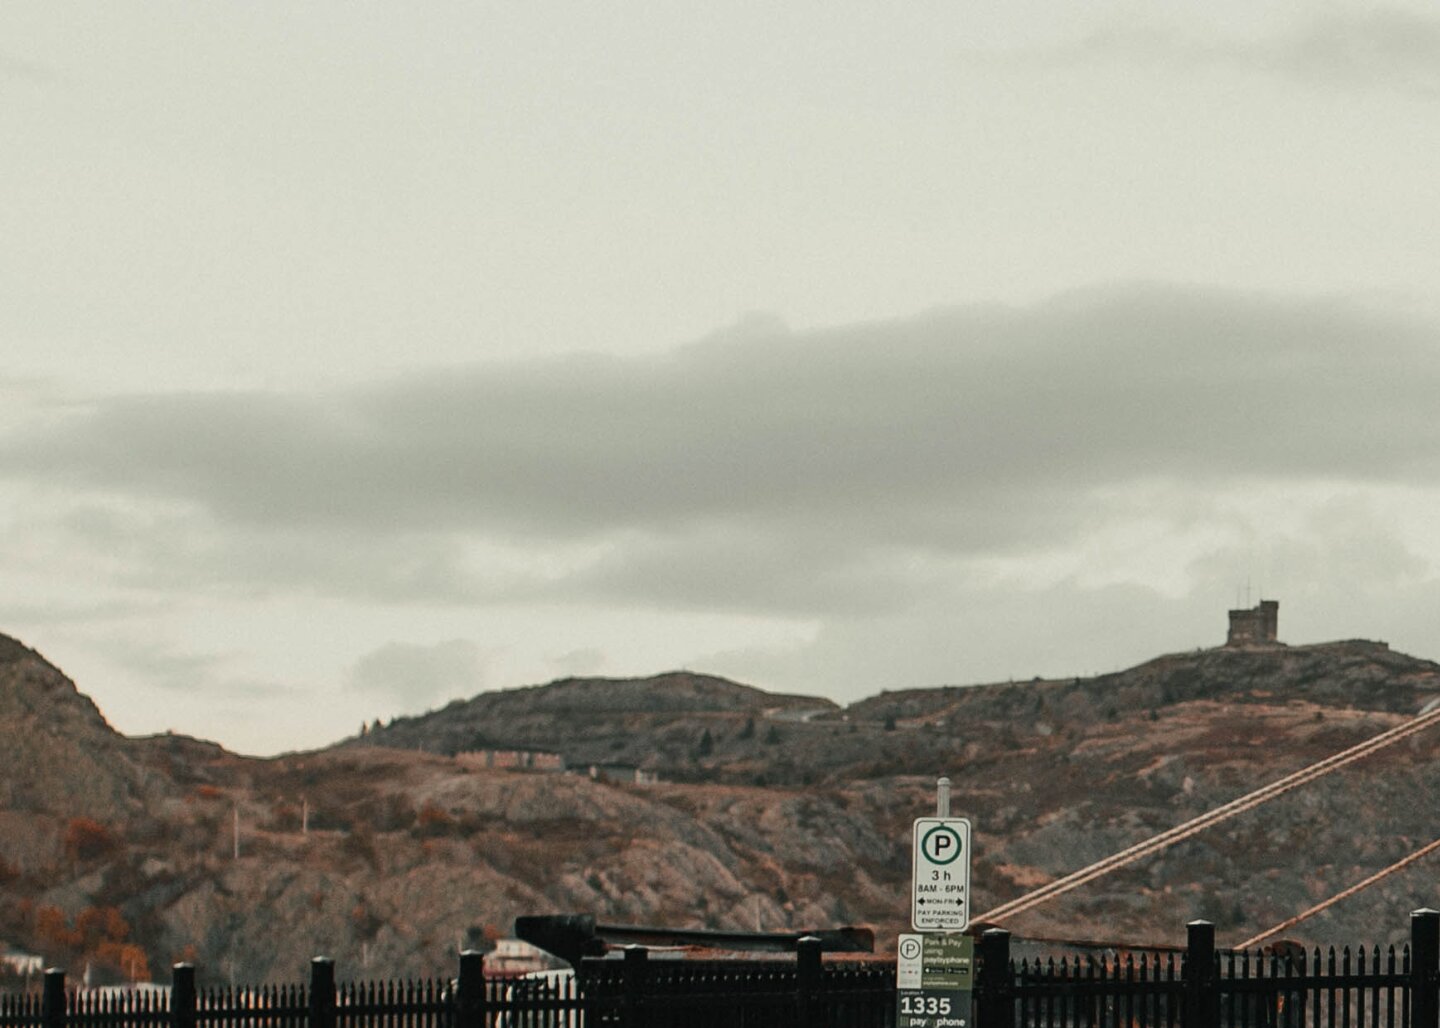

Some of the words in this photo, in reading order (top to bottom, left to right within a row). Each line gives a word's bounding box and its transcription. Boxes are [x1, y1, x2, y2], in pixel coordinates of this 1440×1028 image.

[935, 835, 951, 856] P
[931, 870, 939, 881] 3
[943, 870, 951, 881] h
[918, 884, 937, 893] 8AM
[945, 885, 965, 893] 6PM
[948, 938, 962, 948] Pay
[905, 943, 916, 956] P
[901, 996, 951, 1015] 1335
